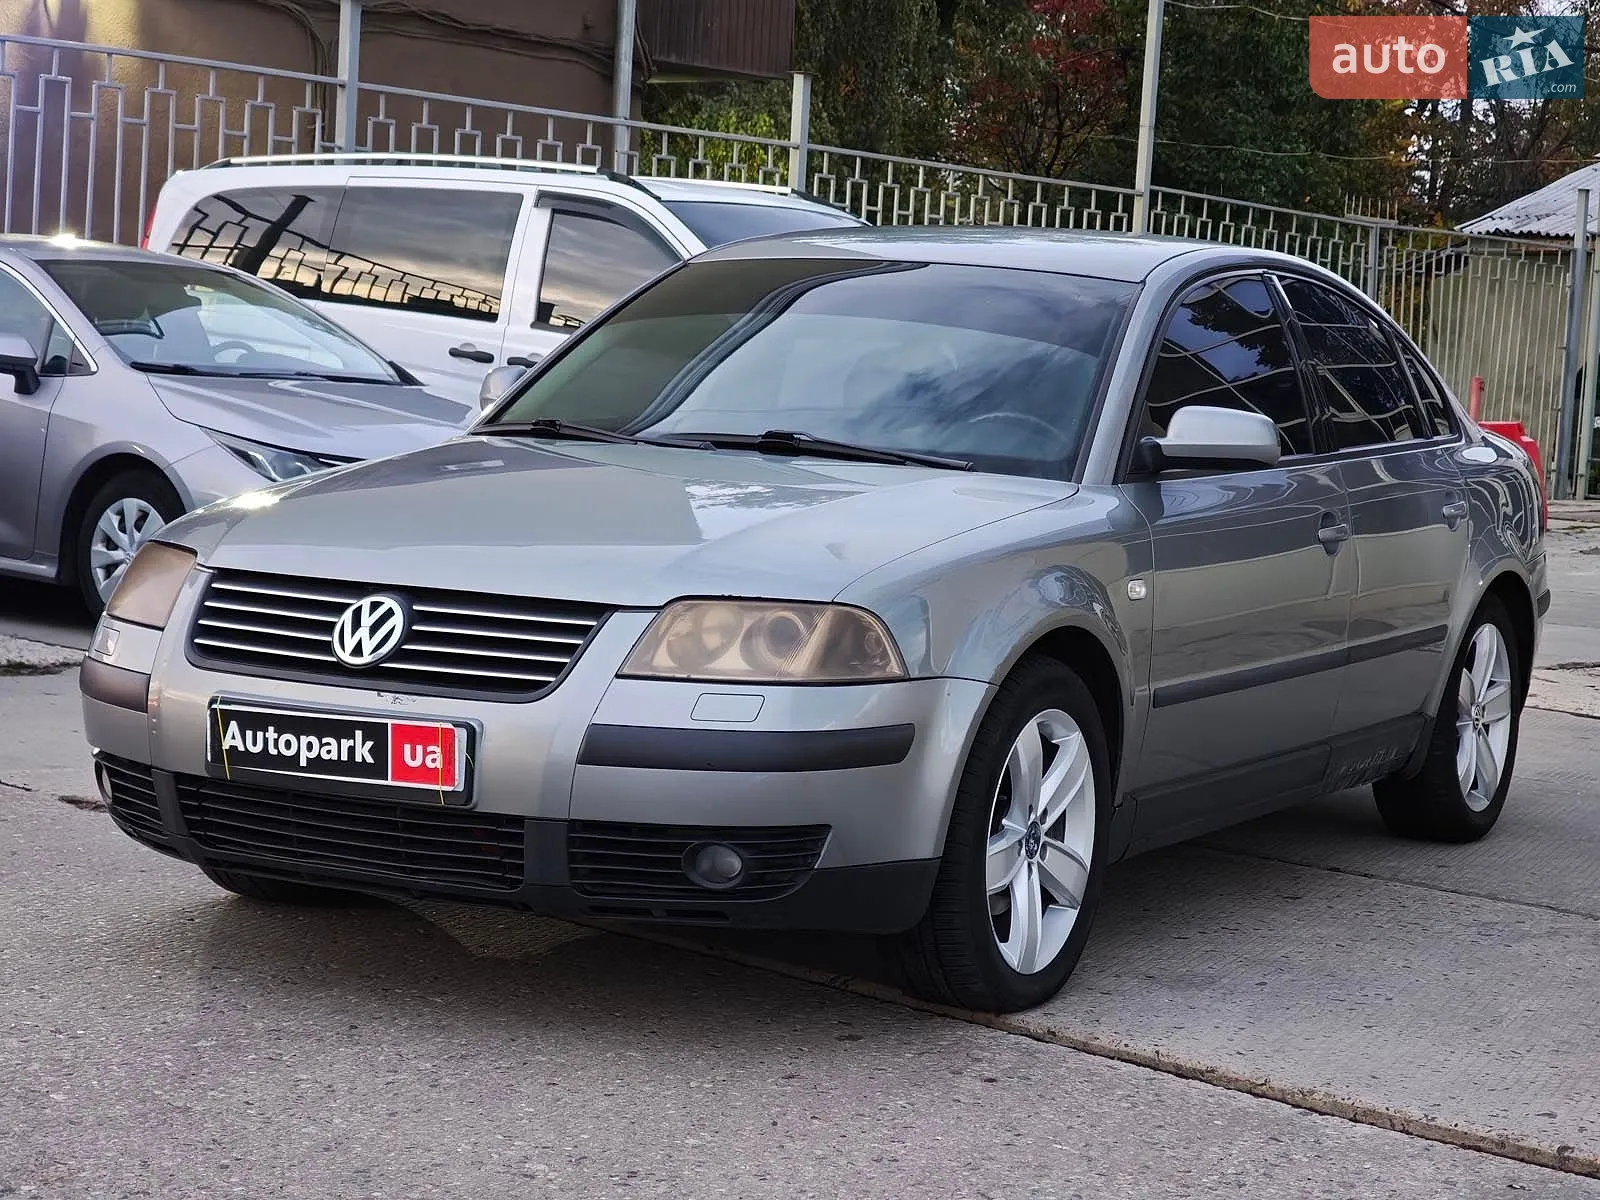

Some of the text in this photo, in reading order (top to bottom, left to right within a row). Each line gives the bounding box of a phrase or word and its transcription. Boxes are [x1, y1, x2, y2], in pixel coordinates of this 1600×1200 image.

[332, 595, 404, 666] VW
[223, 720, 443, 769] Autopark ua
